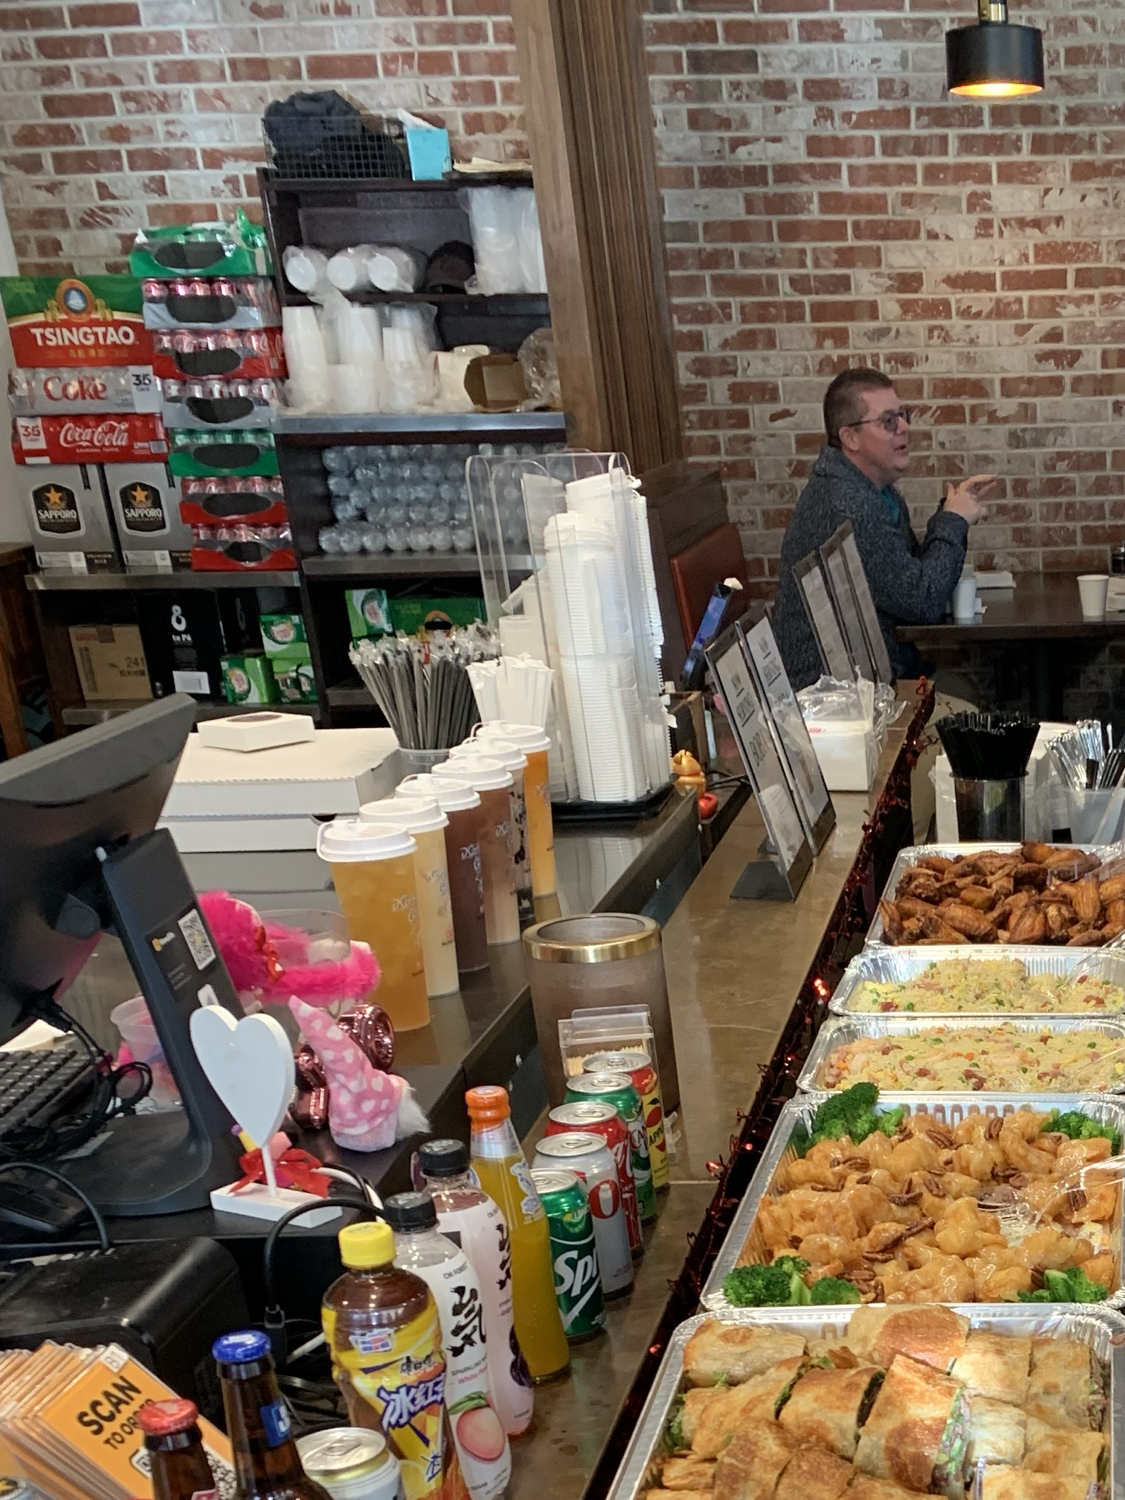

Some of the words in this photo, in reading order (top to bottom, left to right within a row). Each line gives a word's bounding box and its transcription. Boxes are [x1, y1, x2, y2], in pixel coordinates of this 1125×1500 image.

[30, 325, 135, 347] TSINGTAO
[43, 375, 107, 401] Coke
[38, 508, 77, 519] SAPPORO
[124, 507, 162, 518] SAPPORO
[77, 1375, 142, 1436] SCAN
[103, 1431, 125, 1450] TO
